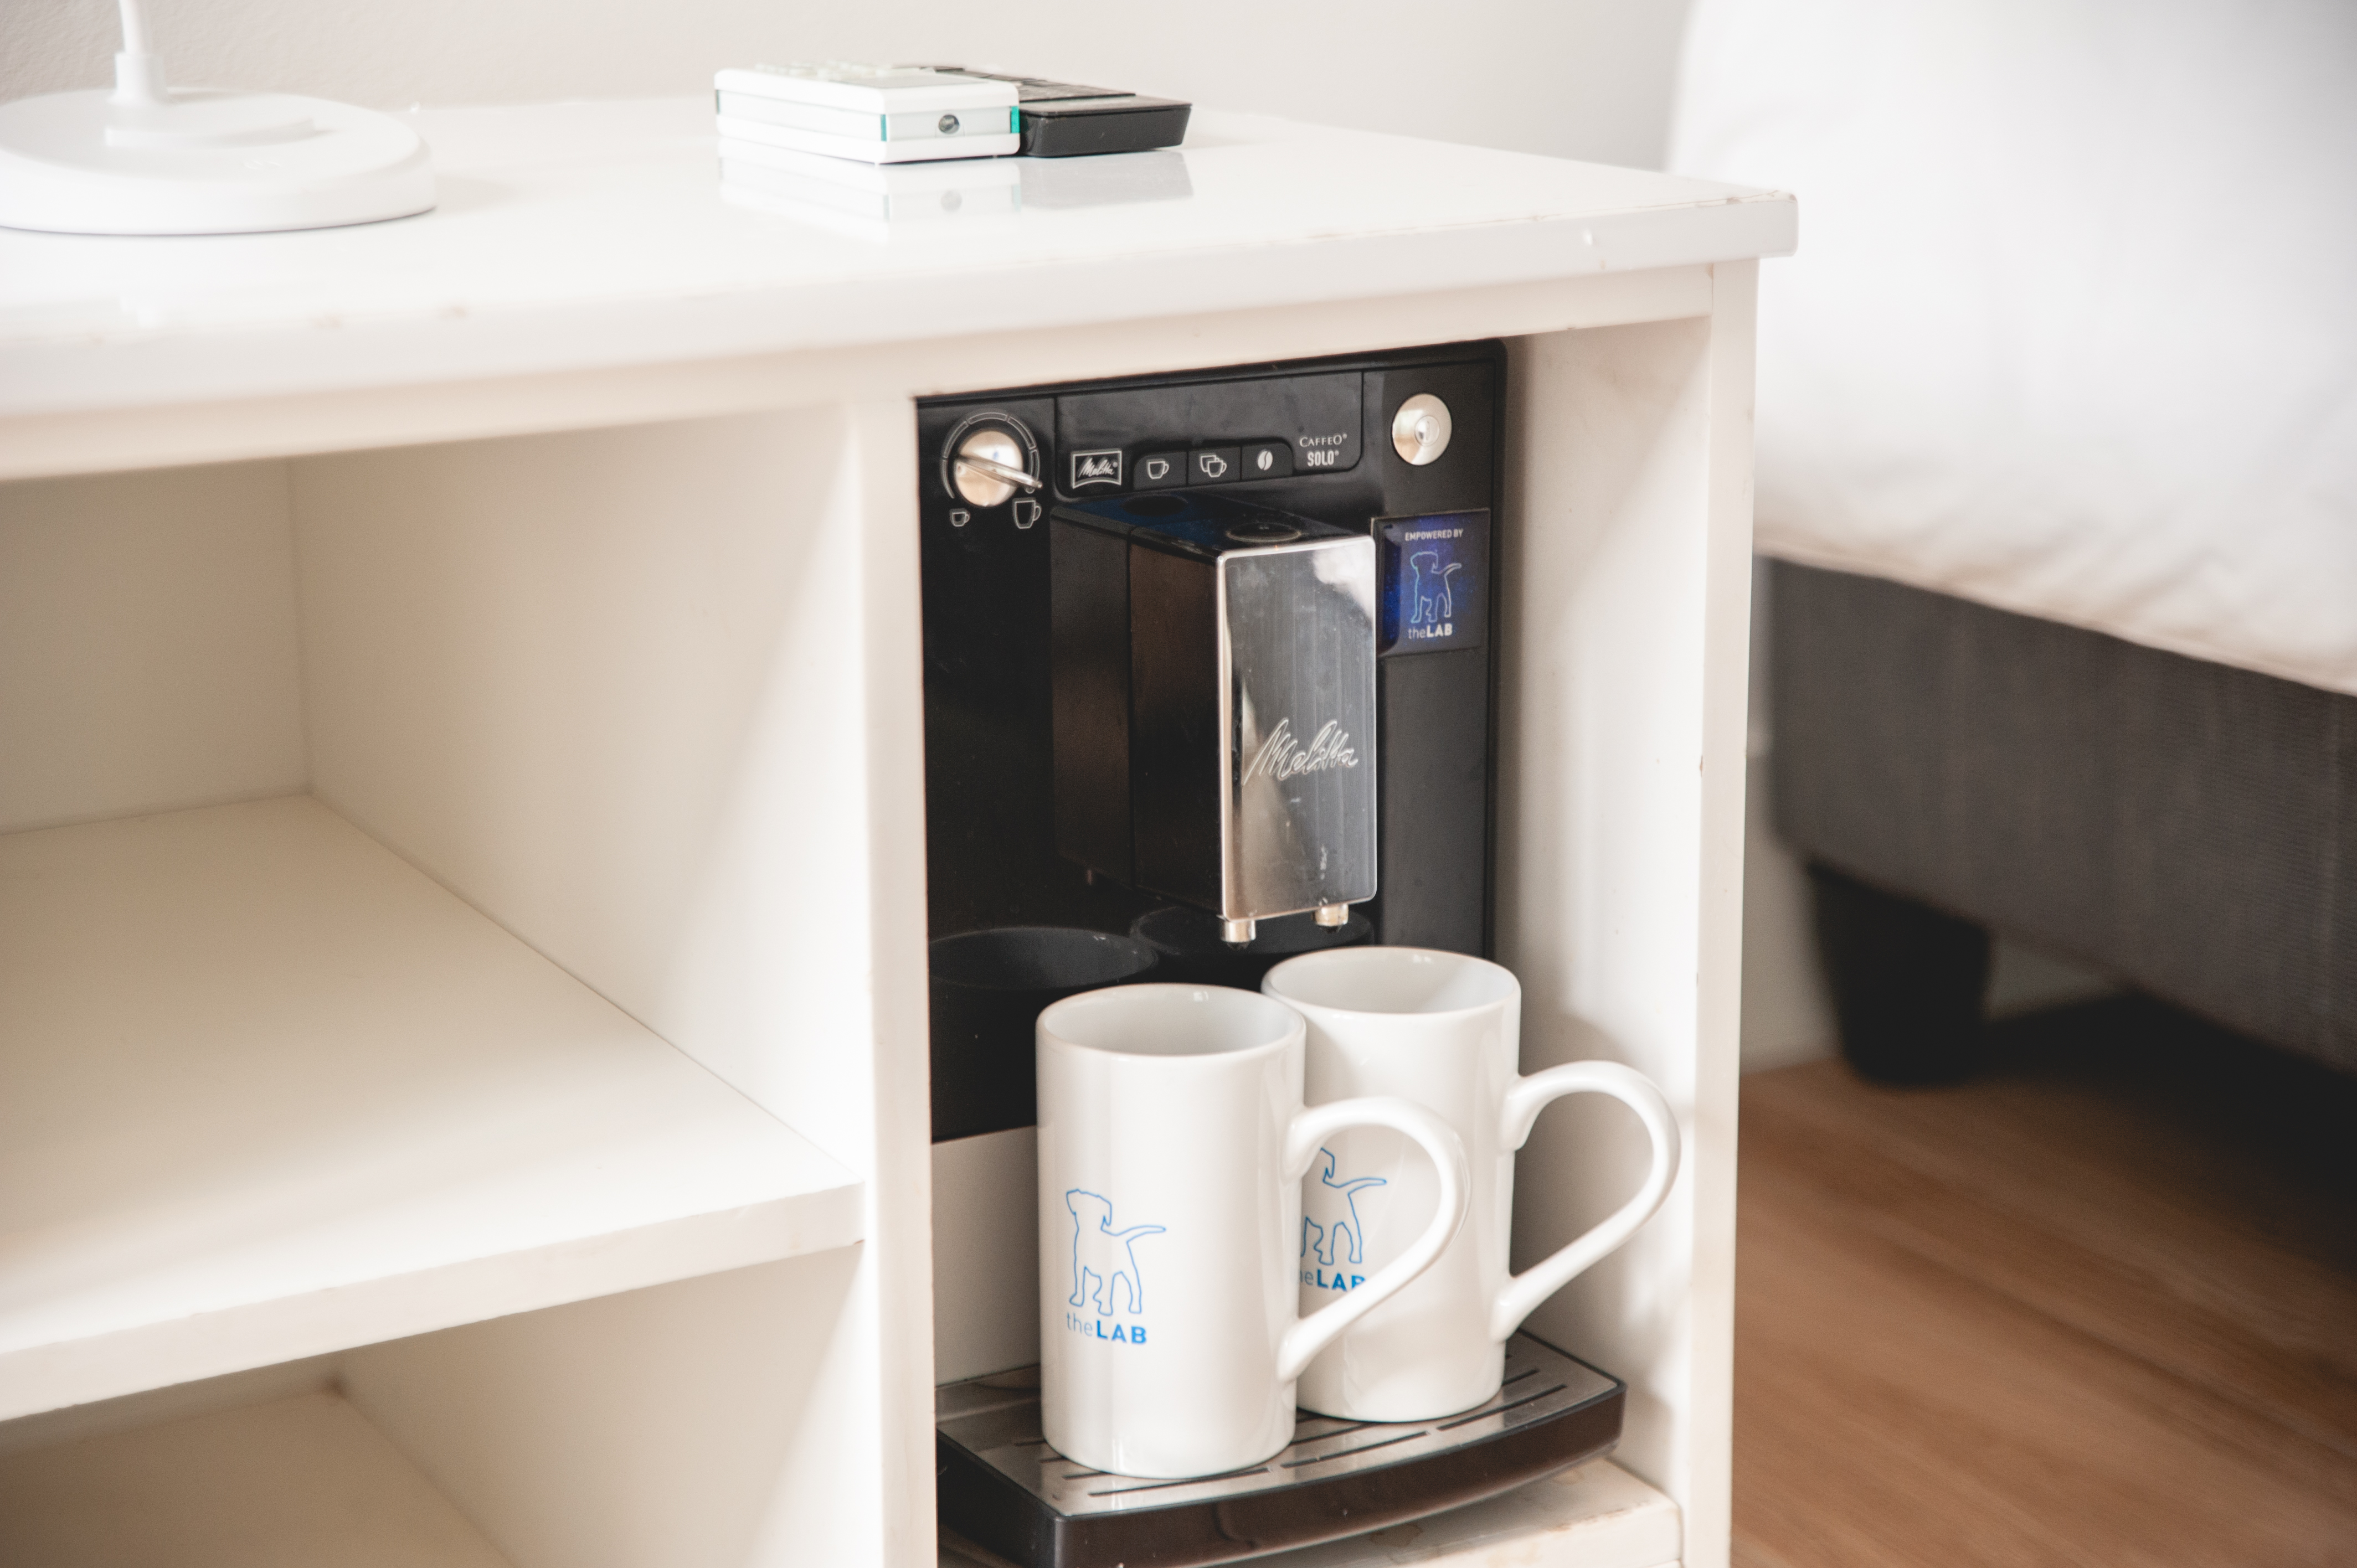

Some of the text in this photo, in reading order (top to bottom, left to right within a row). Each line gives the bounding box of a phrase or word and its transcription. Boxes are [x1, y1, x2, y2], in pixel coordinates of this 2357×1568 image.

[1078, 457, 1115, 477] Melitta
[1405, 528, 1464, 541] EMPOWERED BY
[1408, 623, 1453, 639] theLAB
[1242, 718, 1358, 786] Melitta
[1066, 1312, 1147, 1345] theLAB
